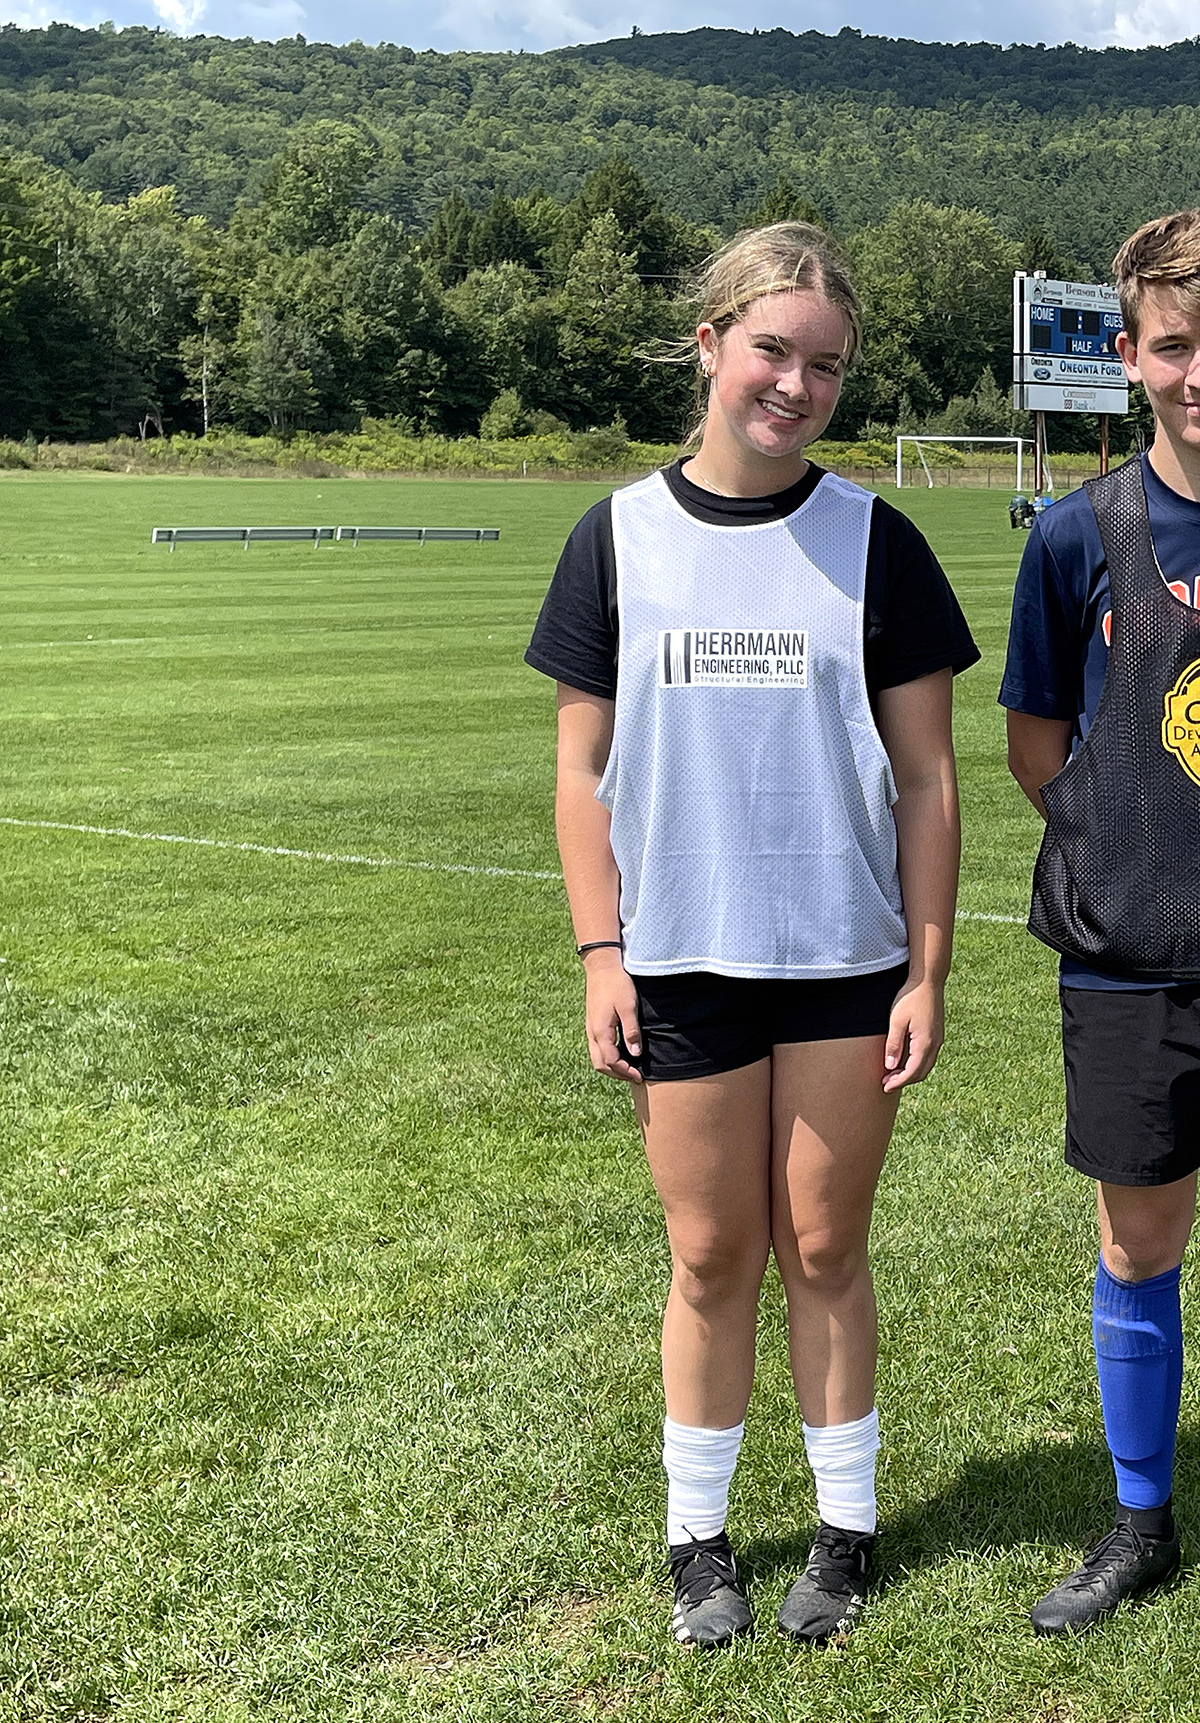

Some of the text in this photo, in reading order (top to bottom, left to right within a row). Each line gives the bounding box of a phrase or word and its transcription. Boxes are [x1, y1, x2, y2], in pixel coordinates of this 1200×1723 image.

[1065, 283, 1118, 301] Benson Agen
[1030, 306, 1055, 322] HOME
[1103, 313, 1124, 328] GUES
[1071, 340, 1093, 353] HALF
[1060, 360, 1099, 375] ONEONTA
[1100, 363, 1122, 377] FORD
[695, 632, 805, 656] HERRMANN
[694, 659, 804, 676] ENGINEERING, PLLC
[694, 675, 805, 686] Structural Engineering
